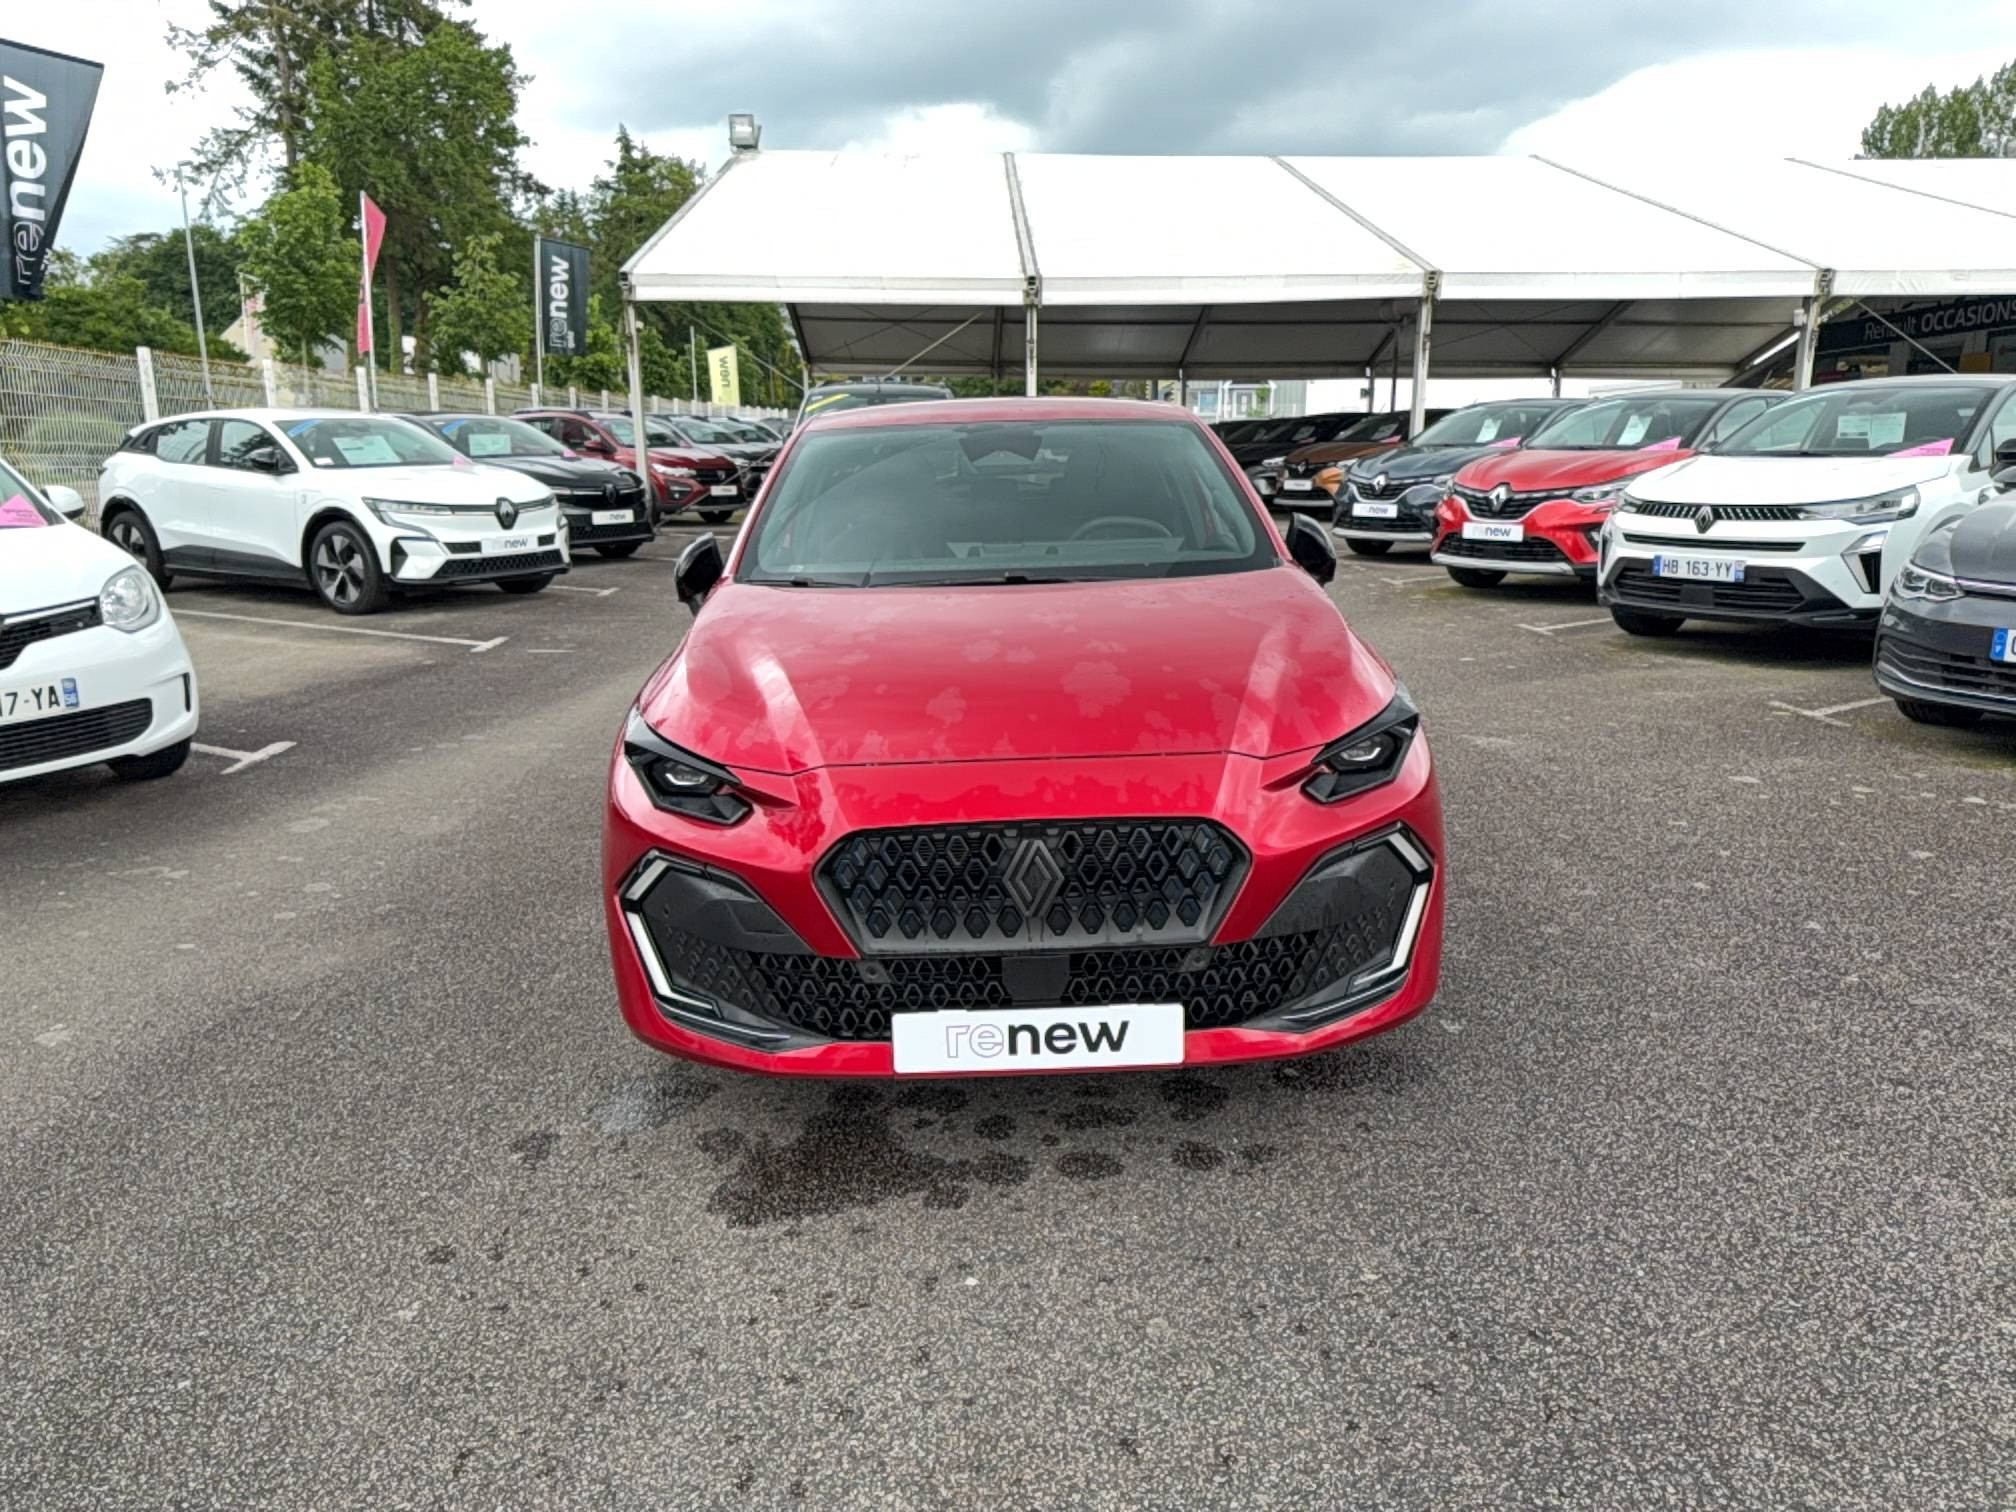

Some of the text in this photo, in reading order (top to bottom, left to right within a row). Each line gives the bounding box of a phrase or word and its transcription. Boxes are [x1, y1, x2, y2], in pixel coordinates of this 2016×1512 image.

[3, 75, 47, 285] renew
[549, 254, 570, 348] renew
[0, 685, 60, 717] 7-YA
[946, 1020, 1130, 1058] renew
